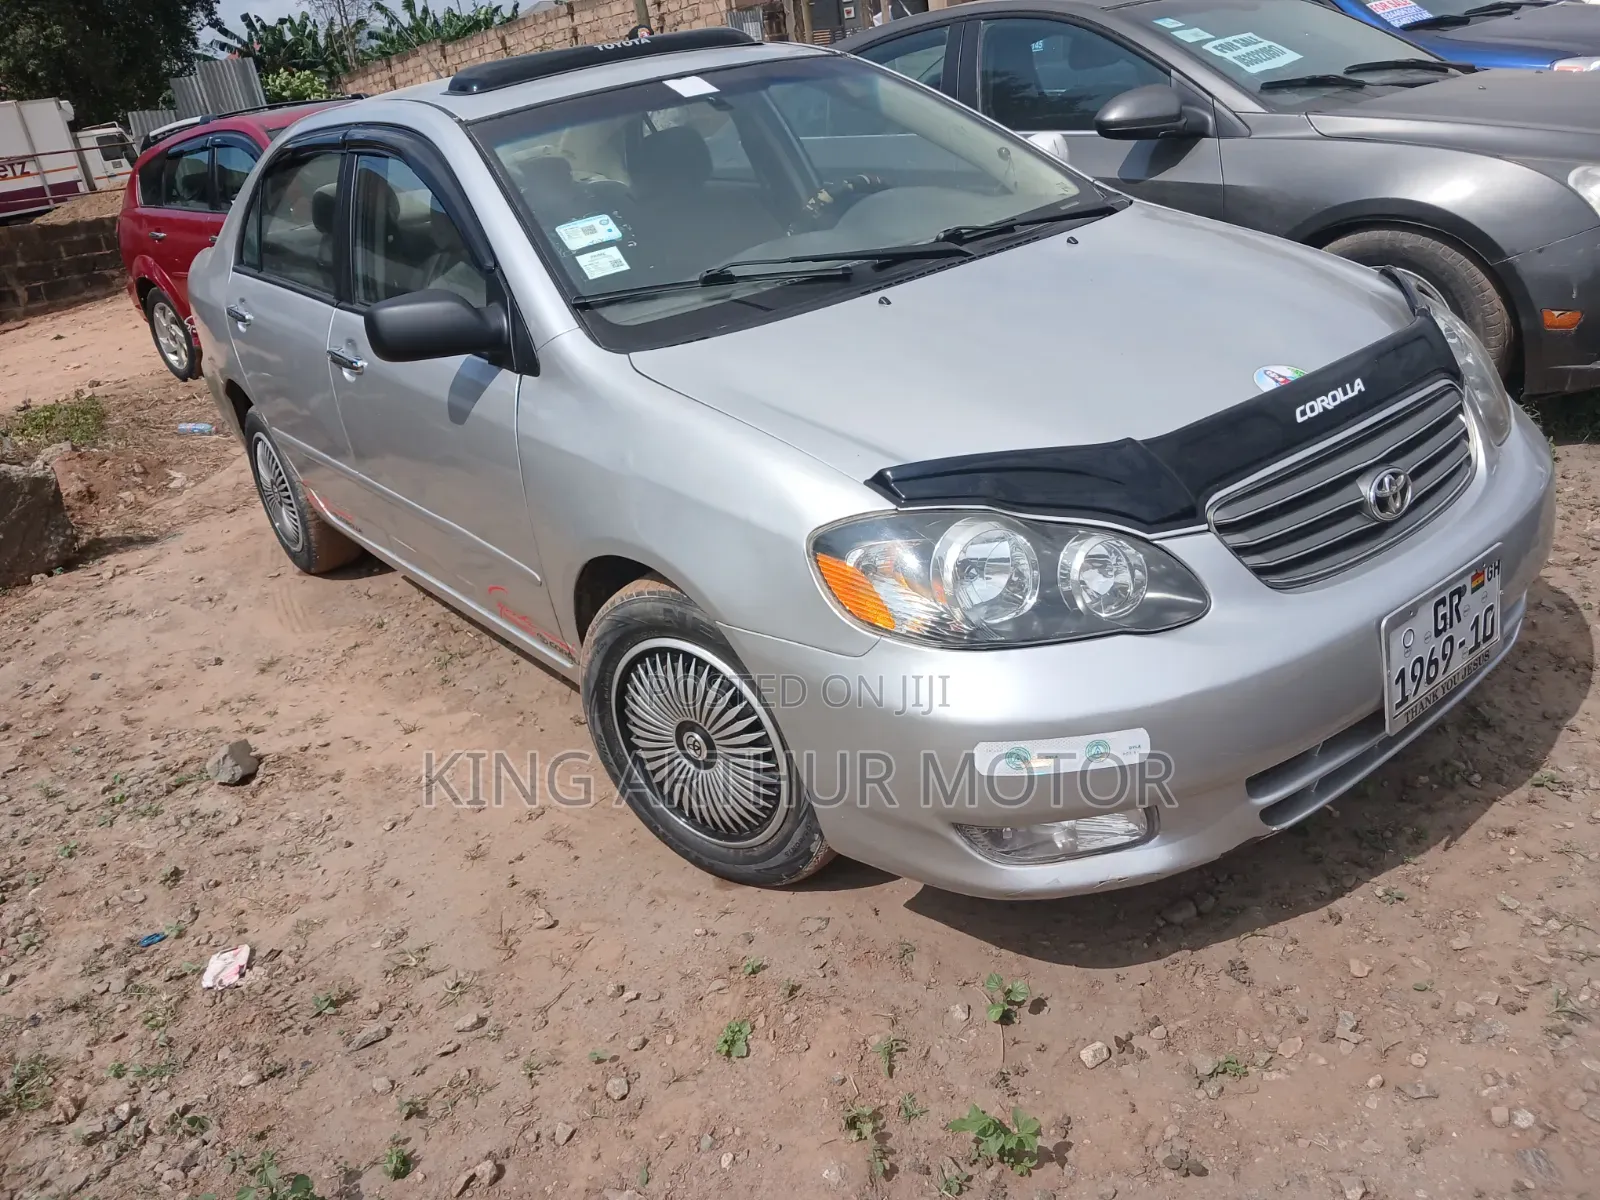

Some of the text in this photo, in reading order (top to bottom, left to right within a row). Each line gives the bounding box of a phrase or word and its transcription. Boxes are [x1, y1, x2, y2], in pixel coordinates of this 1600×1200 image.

[594, 38, 651, 51] TOYOTA
[1212, 36, 1264, 54] FOR SALE
[1296, 378, 1365, 423] COROLLA
[1486, 560, 1500, 583] GH
[1433, 586, 1463, 638] GR
[1394, 603, 1495, 711] 1969-10
[1404, 650, 1491, 724] THANK YOU JESUS
